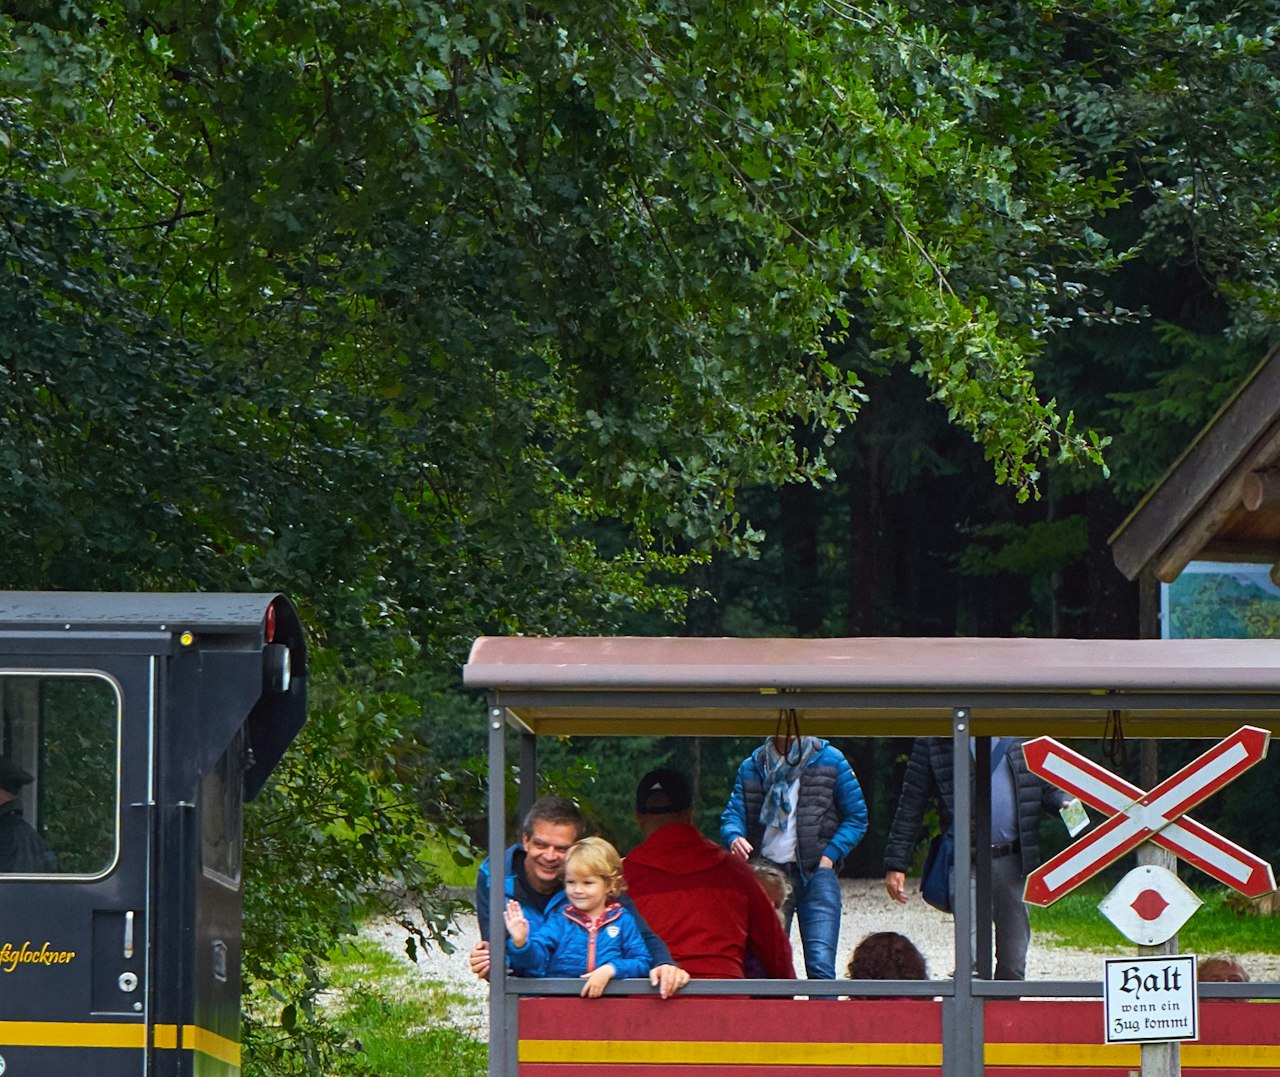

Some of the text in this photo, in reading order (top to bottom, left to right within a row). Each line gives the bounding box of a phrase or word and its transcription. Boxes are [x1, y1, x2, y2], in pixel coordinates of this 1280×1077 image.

[1119, 966, 1182, 1000] Halt
[1121, 1001, 1180, 1012] wenn ein
[1114, 1016, 1188, 1034] Zug kommt
